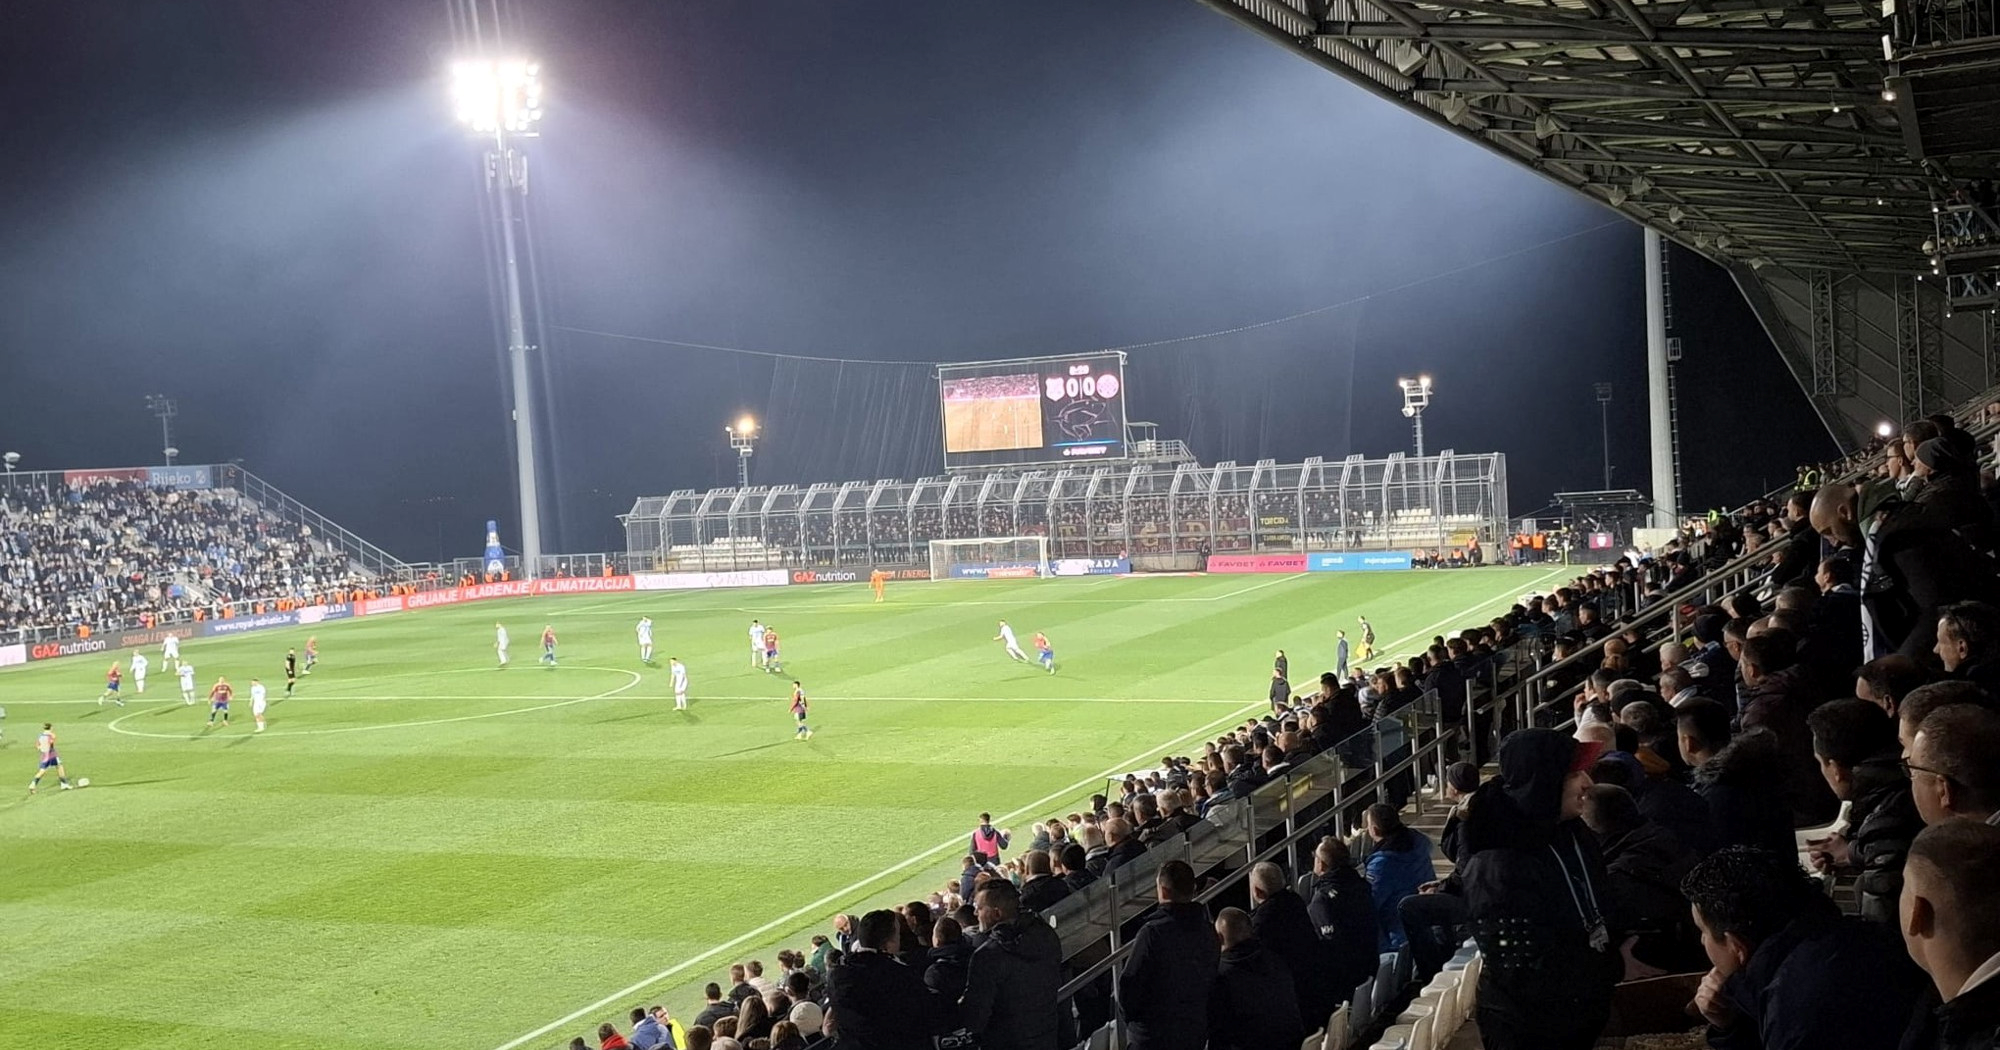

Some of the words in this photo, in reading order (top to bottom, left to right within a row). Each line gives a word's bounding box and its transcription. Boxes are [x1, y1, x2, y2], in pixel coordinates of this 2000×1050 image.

[793, 570, 856, 582] GAZnutrition
[408, 589, 459, 607] GRIJANJE
[540, 579, 631, 592] KLIMATIZACIJA
[32, 639, 106, 659] GAZnutrition
